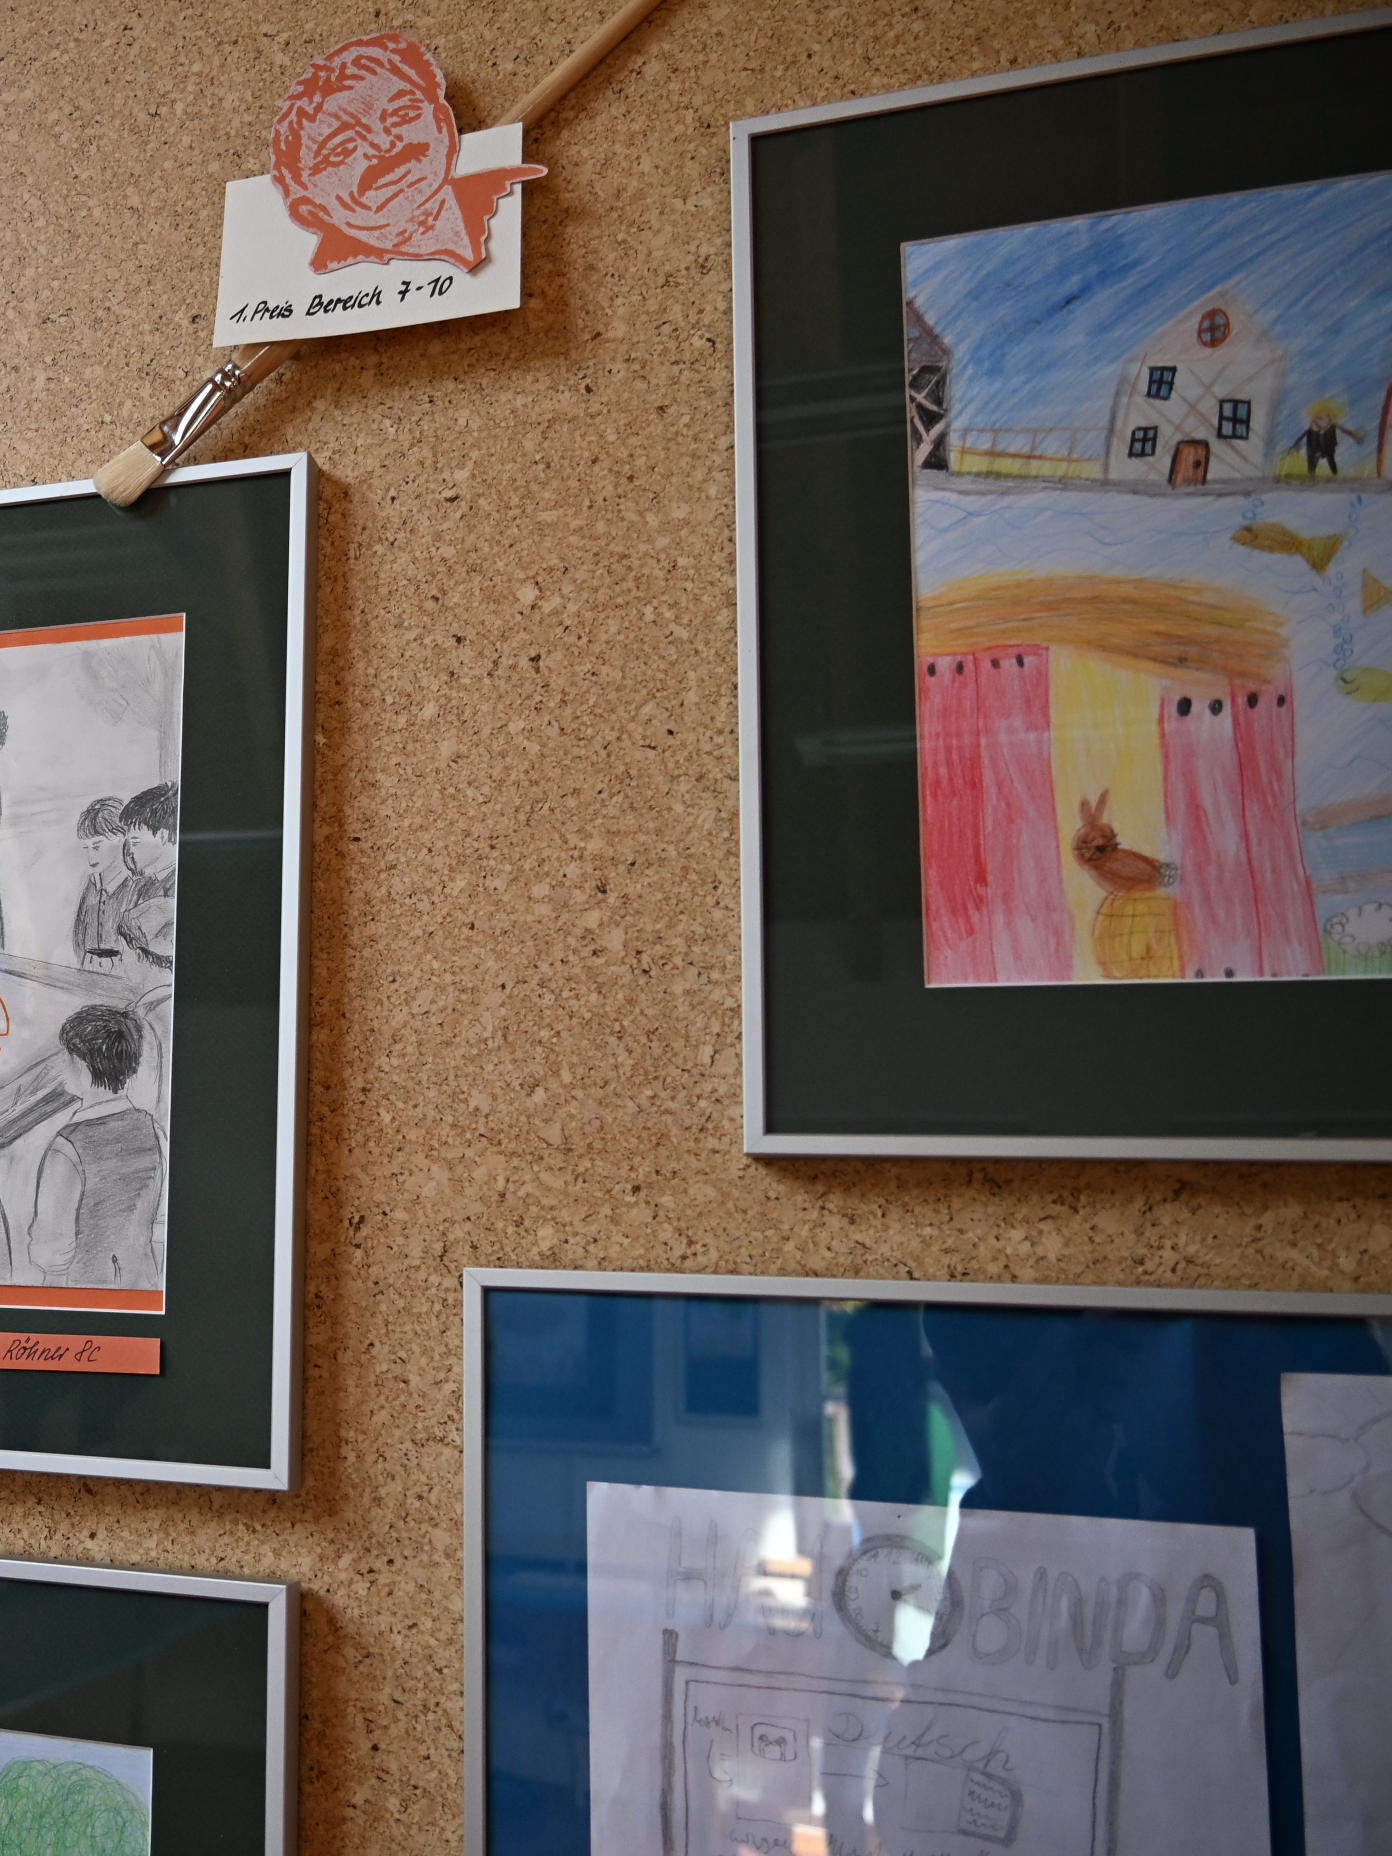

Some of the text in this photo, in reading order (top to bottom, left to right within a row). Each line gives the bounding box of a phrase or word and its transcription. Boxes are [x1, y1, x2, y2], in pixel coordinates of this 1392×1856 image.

[305, 285, 383, 317] Bereich
[2, 1336, 70, 1361] Röhner
[968, 1556, 1240, 1687] BINDA
[827, 1702, 1016, 1772] Dutsch
